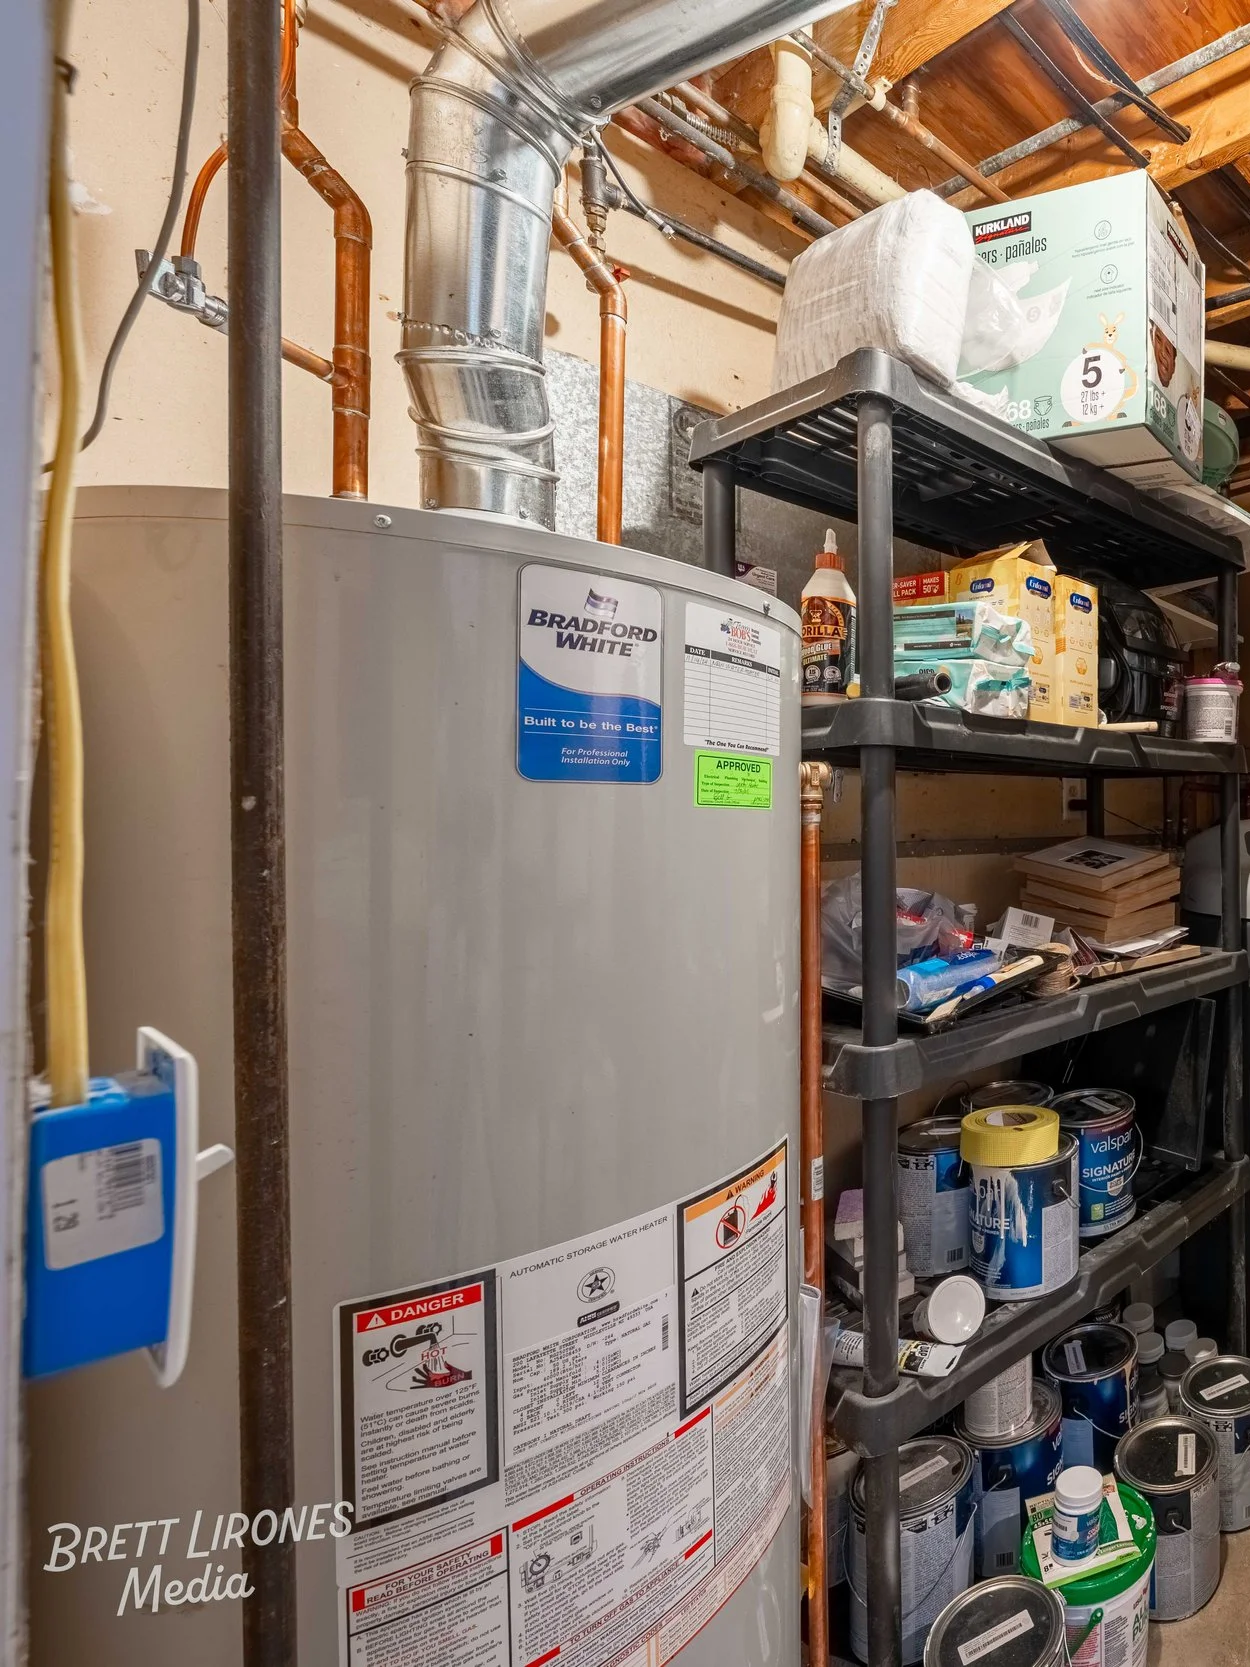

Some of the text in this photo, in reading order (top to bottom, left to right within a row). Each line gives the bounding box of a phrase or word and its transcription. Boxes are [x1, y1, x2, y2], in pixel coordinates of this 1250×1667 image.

[975, 215, 1030, 237] KIRKLAND
[1006, 237, 1047, 262] pañales
[1082, 355, 1102, 388] 5
[1081, 391, 1099, 402] 27 lbs
[1082, 404, 1097, 415] 12 kg
[901, 588, 916, 596] PACK
[528, 609, 657, 642] BRADFORD
[556, 631, 633, 656] WHITE
[690, 647, 706, 655] DATE
[816, 642, 832, 651] GLUE
[524, 716, 556, 727] Built
[561, 719, 575, 728] to
[580, 720, 596, 730] be
[601, 722, 622, 731] the
[561, 756, 630, 767] Installation Only
[578, 748, 628, 757] Professional
[716, 760, 760, 773] APPROVED
[1091, 1128, 1133, 1153] valspar
[1082, 1148, 1135, 1178] SIGNATURE
[735, 1169, 765, 1193] WARNING
[510, 1216, 668, 1278] AUTOMATIC STORAGE WATER HEATER
[391, 1293, 464, 1321] DANGER
[421, 1346, 447, 1361] HOT
[434, 1372, 465, 1387] BURN
[360, 1412, 384, 1422] Water
[386, 1399, 433, 1416] temperature
[436, 1392, 452, 1402] over
[361, 1424, 393, 1437] instantly
[406, 1413, 427, 1425] death
[430, 1408, 447, 1417] from
[449, 1399, 475, 1411] scalds.
[388, 1415, 403, 1423] can
[405, 1407, 428, 1417] cause
[431, 1397, 457, 1409] severe
[459, 1390, 480, 1401] burns
[361, 1407, 475, 1447] Children, disabled and elderly
[361, 1447, 374, 1455] are
[386, 1434, 415, 1448] highest
[417, 1429, 430, 1438] risk
[442, 1420, 463, 1430] being
[361, 1448, 394, 1462] scalded.
[580, 1437, 670, 1496] OPERATING INSTRUCTIONS
[367, 1550, 489, 1603] READ BEFORE OPERATING
[385, 1551, 472, 1590] FOR YOUR SAFETY
